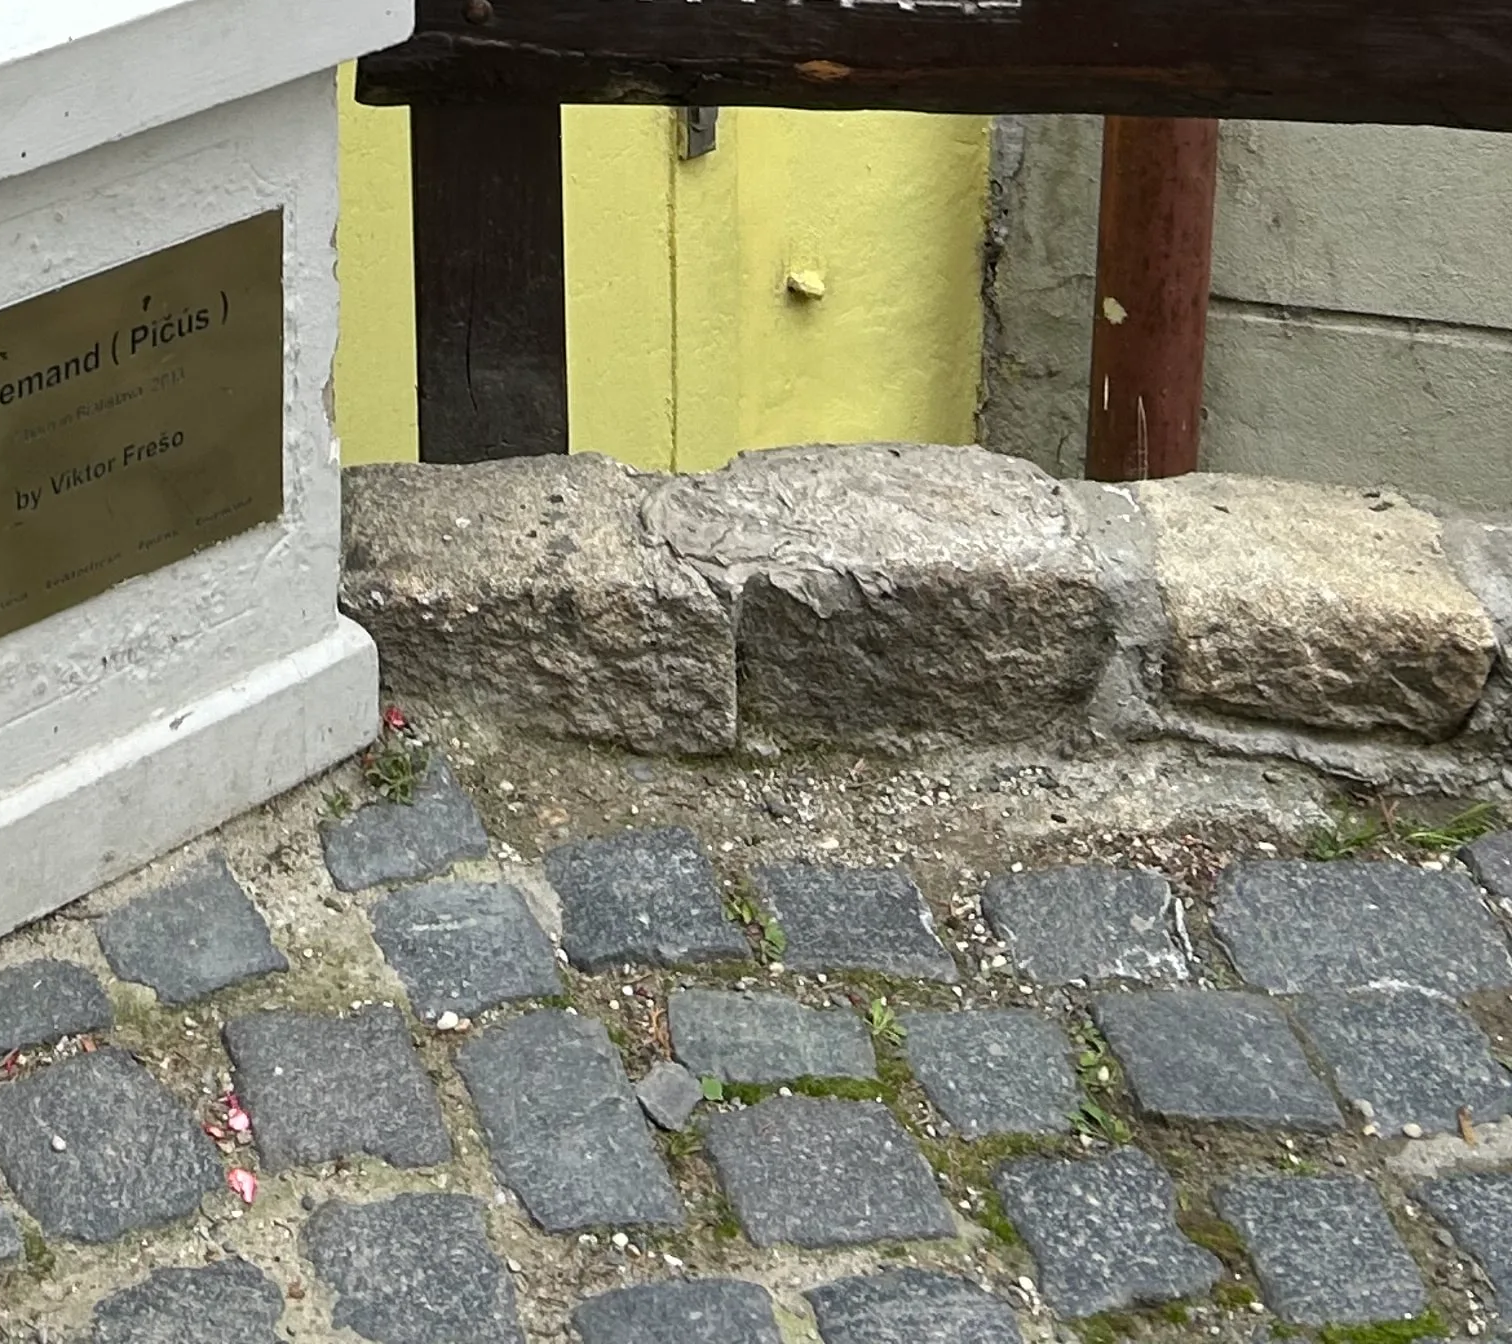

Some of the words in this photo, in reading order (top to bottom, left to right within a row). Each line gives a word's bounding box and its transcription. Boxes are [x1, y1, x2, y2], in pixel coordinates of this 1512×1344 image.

[15, 488, 42, 512] by
[50, 457, 117, 496] Viktor
[122, 429, 184, 467] Frešo
